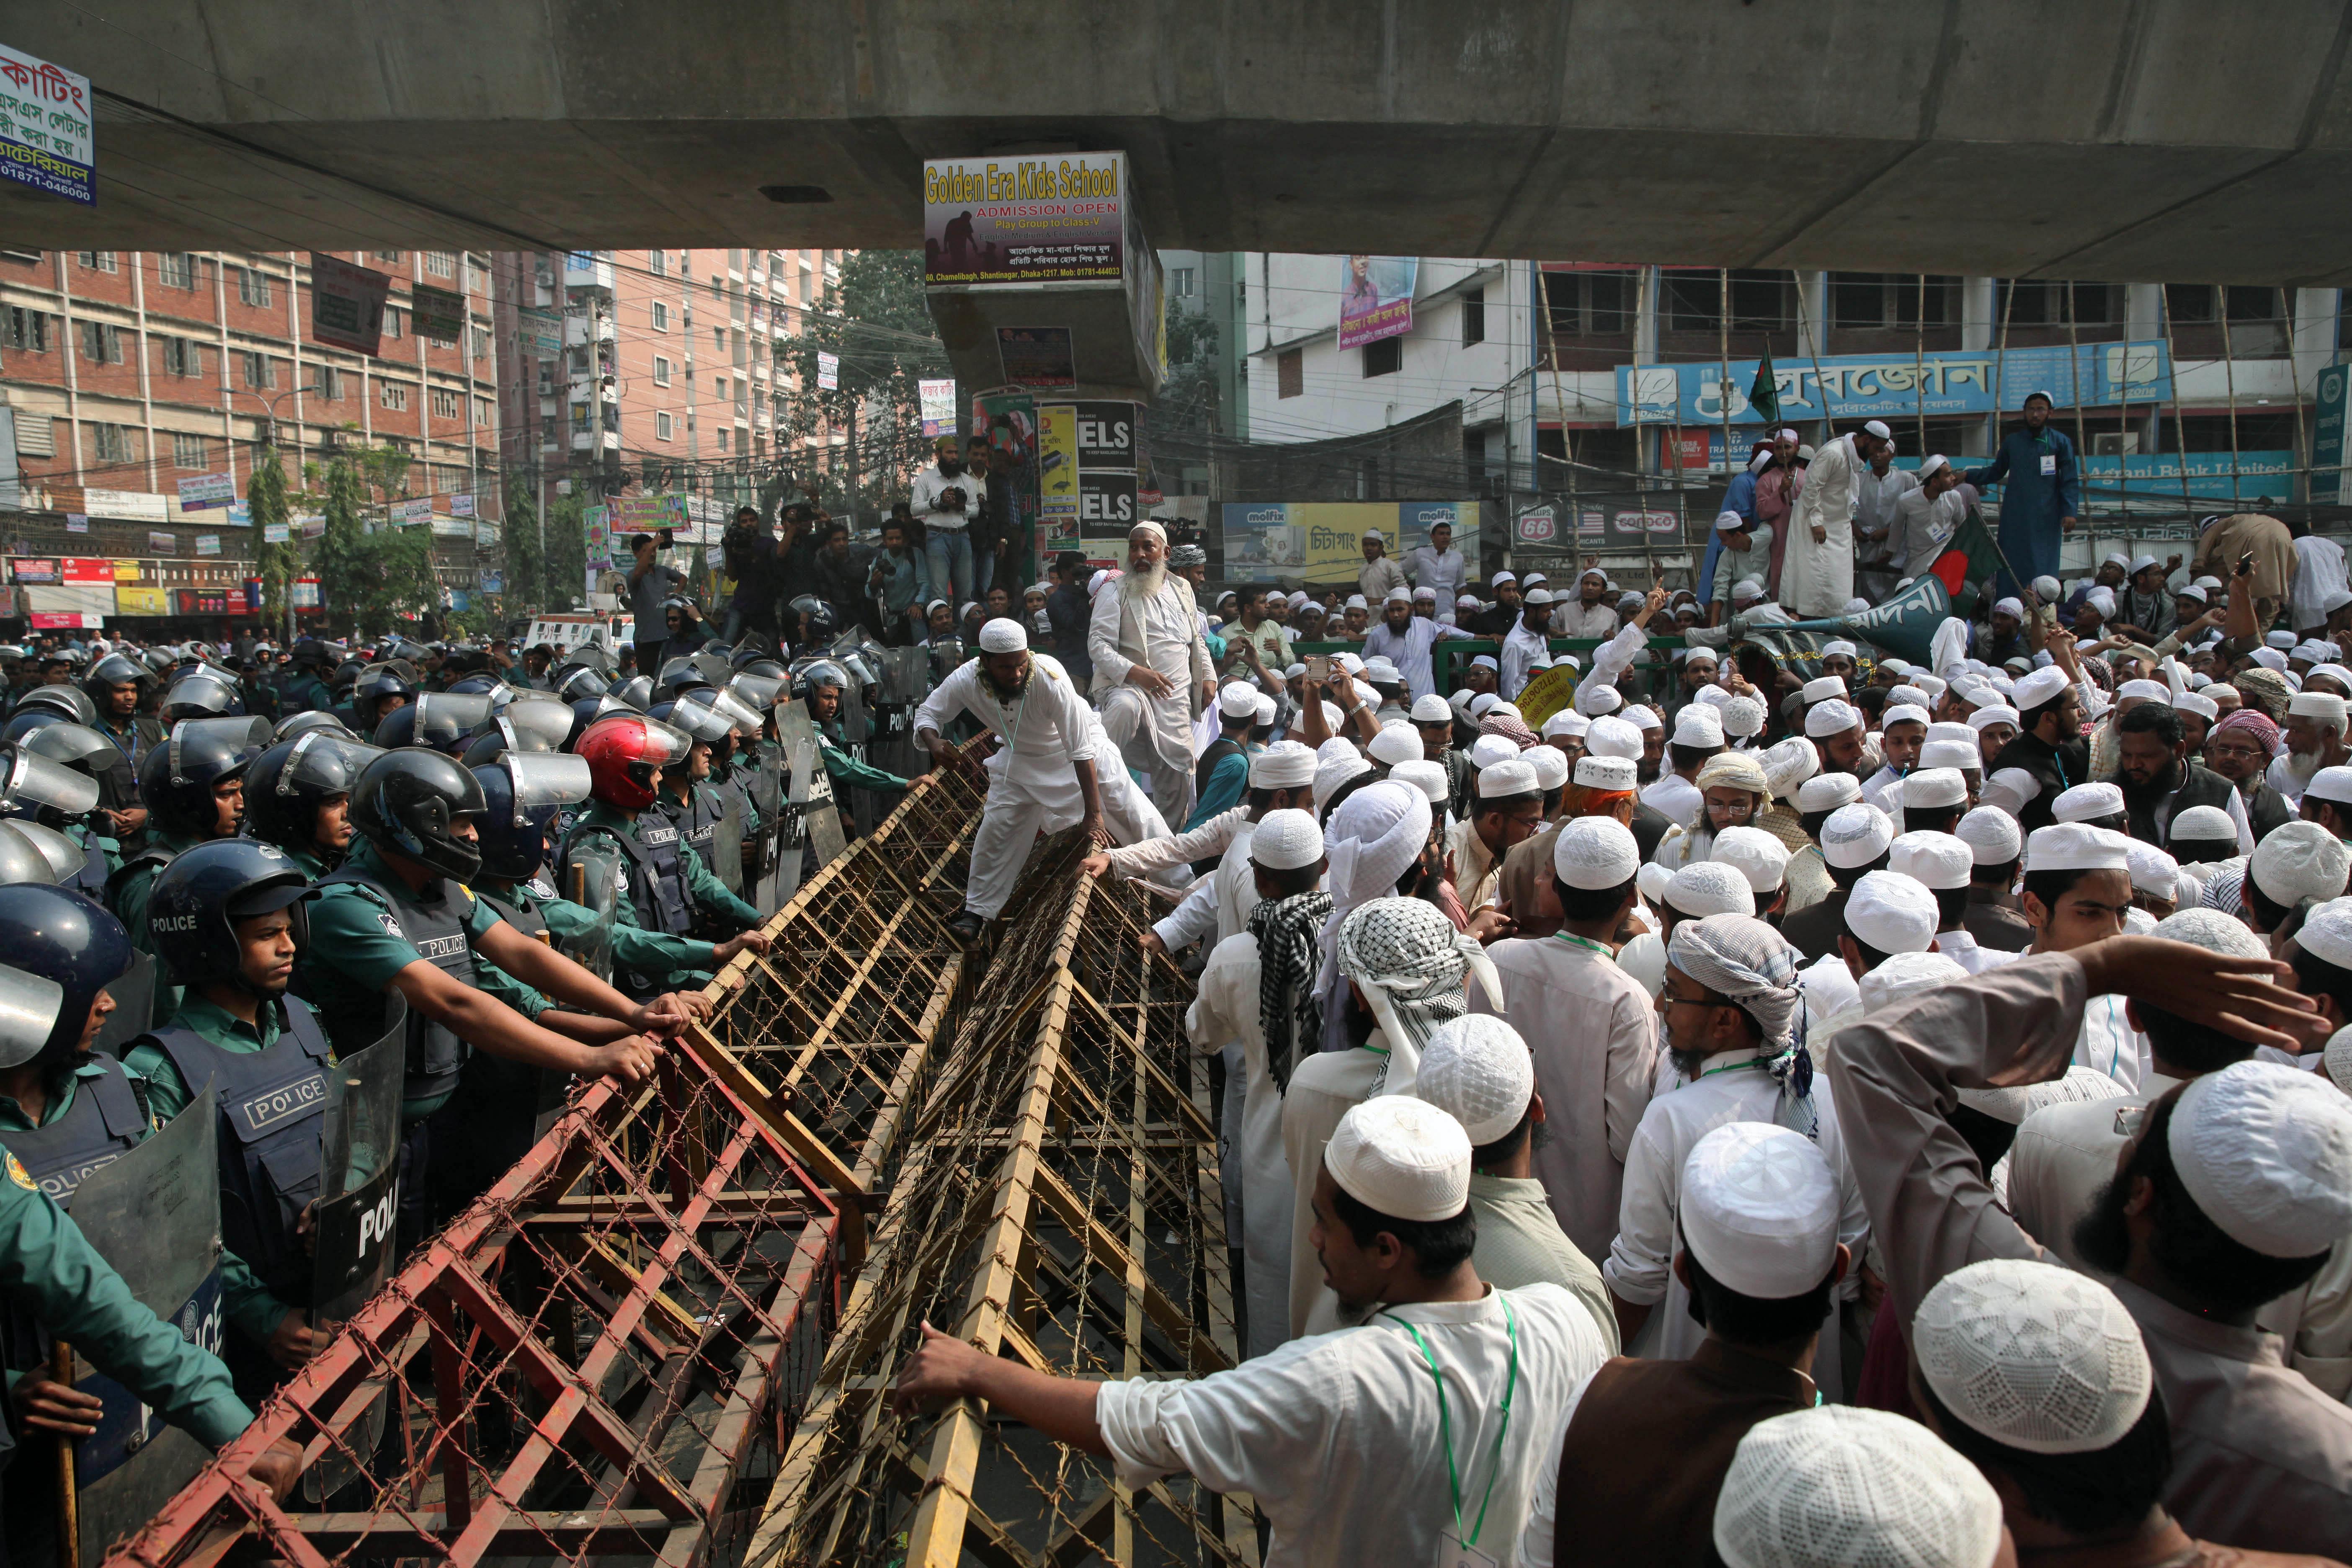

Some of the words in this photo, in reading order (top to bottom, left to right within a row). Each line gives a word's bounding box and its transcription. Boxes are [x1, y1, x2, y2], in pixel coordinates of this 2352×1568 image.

[49, 110, 89, 141] লেটার
[0, 141, 88, 183] ্যাটেরিয়াল
[1, 165, 90, 201] 01871-046000
[925, 166, 984, 204] Golden
[987, 164, 1015, 201] Era
[1019, 162, 1056, 200] Kids
[1060, 159, 1117, 199] School
[976, 204, 1066, 218] ADMISSION
[1073, 203, 1117, 215] OPEN
[995, 220, 1016, 230] Play
[1019, 219, 1048, 229] Group
[1051, 218, 1060, 227] to
[1063, 217, 1099, 227] Class-V
[979, 233, 1009, 242] English
[1009, 246, 1044, 255] আলোকিত
[1033, 255, 1057, 264] পরিবার
[926, 273, 935, 282] 60,
[936, 272, 979, 282] Chamelibagh,
[980, 271, 1020, 281] Shantinagar,
[1021, 268, 1059, 279] Dhaka-1217.
[1060, 268, 1075, 277] Mob:
[1077, 267, 1119, 276] 01781-444033
[2089, 464, 2152, 485] Agrani
[2159, 464, 2209, 477] Bank
[2215, 462, 2288, 476] Limited
[1248, 509, 1286, 523] molfix
[1419, 509, 1456, 522] molfix
[1524, 520, 1549, 535] 66
[1310, 525, 1357, 553] চিটাগাং
[655, 830, 675, 842] POLICE
[152, 915, 197, 932] POLICE
[430, 936, 463, 956] POLICE
